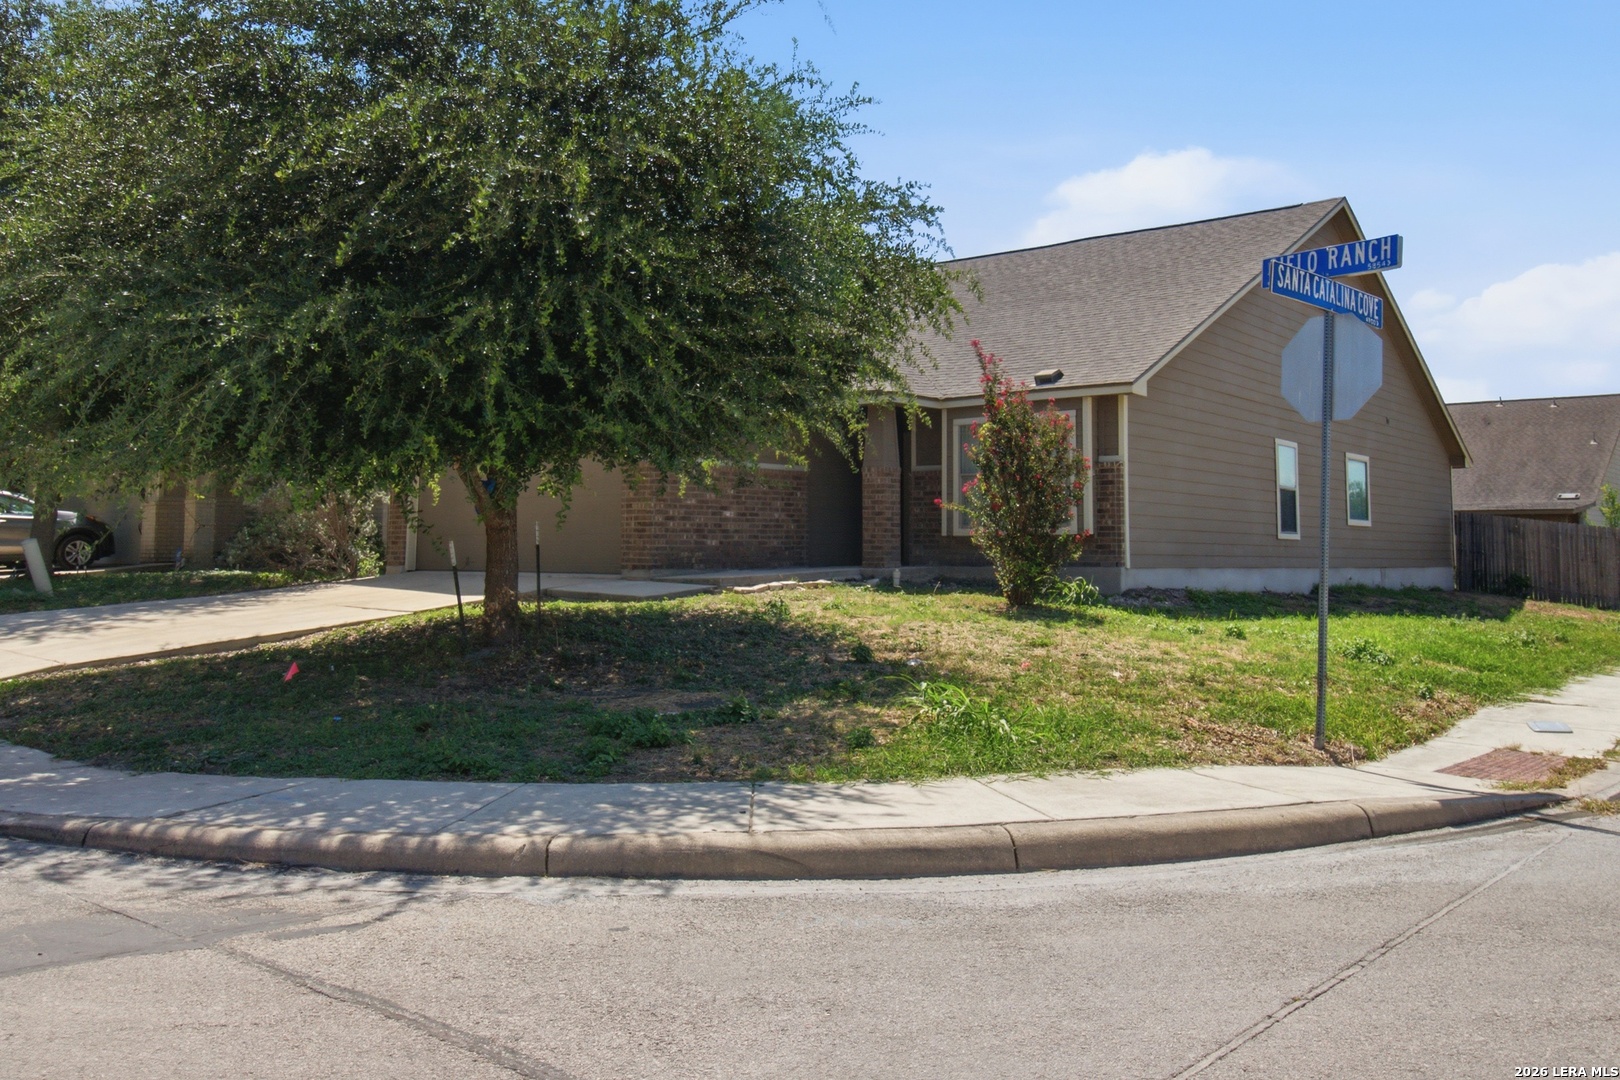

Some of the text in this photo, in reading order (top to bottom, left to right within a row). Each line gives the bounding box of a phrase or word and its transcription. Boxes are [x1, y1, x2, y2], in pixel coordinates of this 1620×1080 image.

[1328, 236, 1391, 269] RANCH
[1277, 264, 1379, 319] SANTA CATALINA COVE
